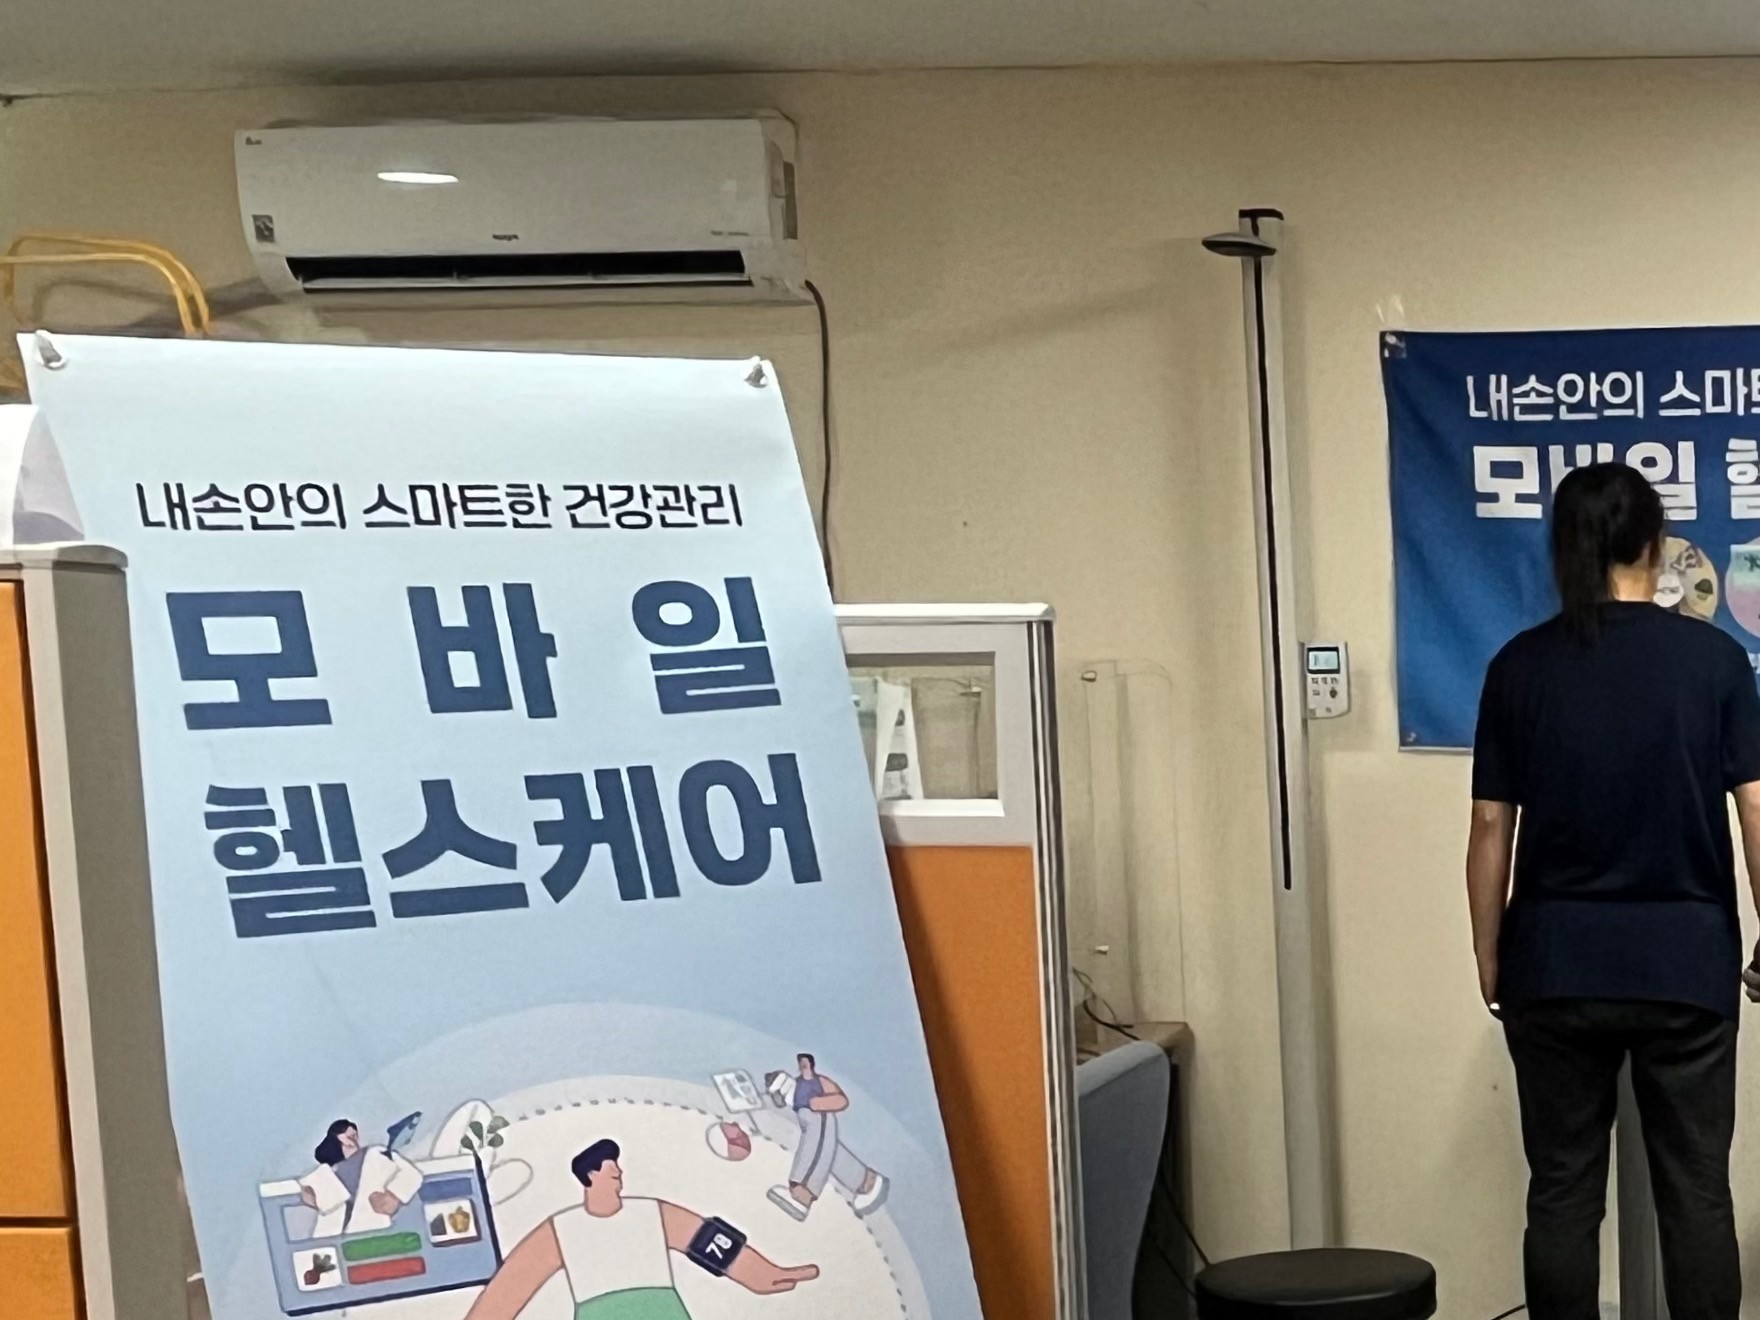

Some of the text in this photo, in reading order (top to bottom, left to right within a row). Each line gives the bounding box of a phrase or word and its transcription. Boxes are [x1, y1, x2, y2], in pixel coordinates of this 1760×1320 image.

[1466, 371, 1645, 421] 내손안의
[135, 481, 744, 532] 내손안의 스마트한 건강관리
[204, 752, 822, 939] 헬스케어
